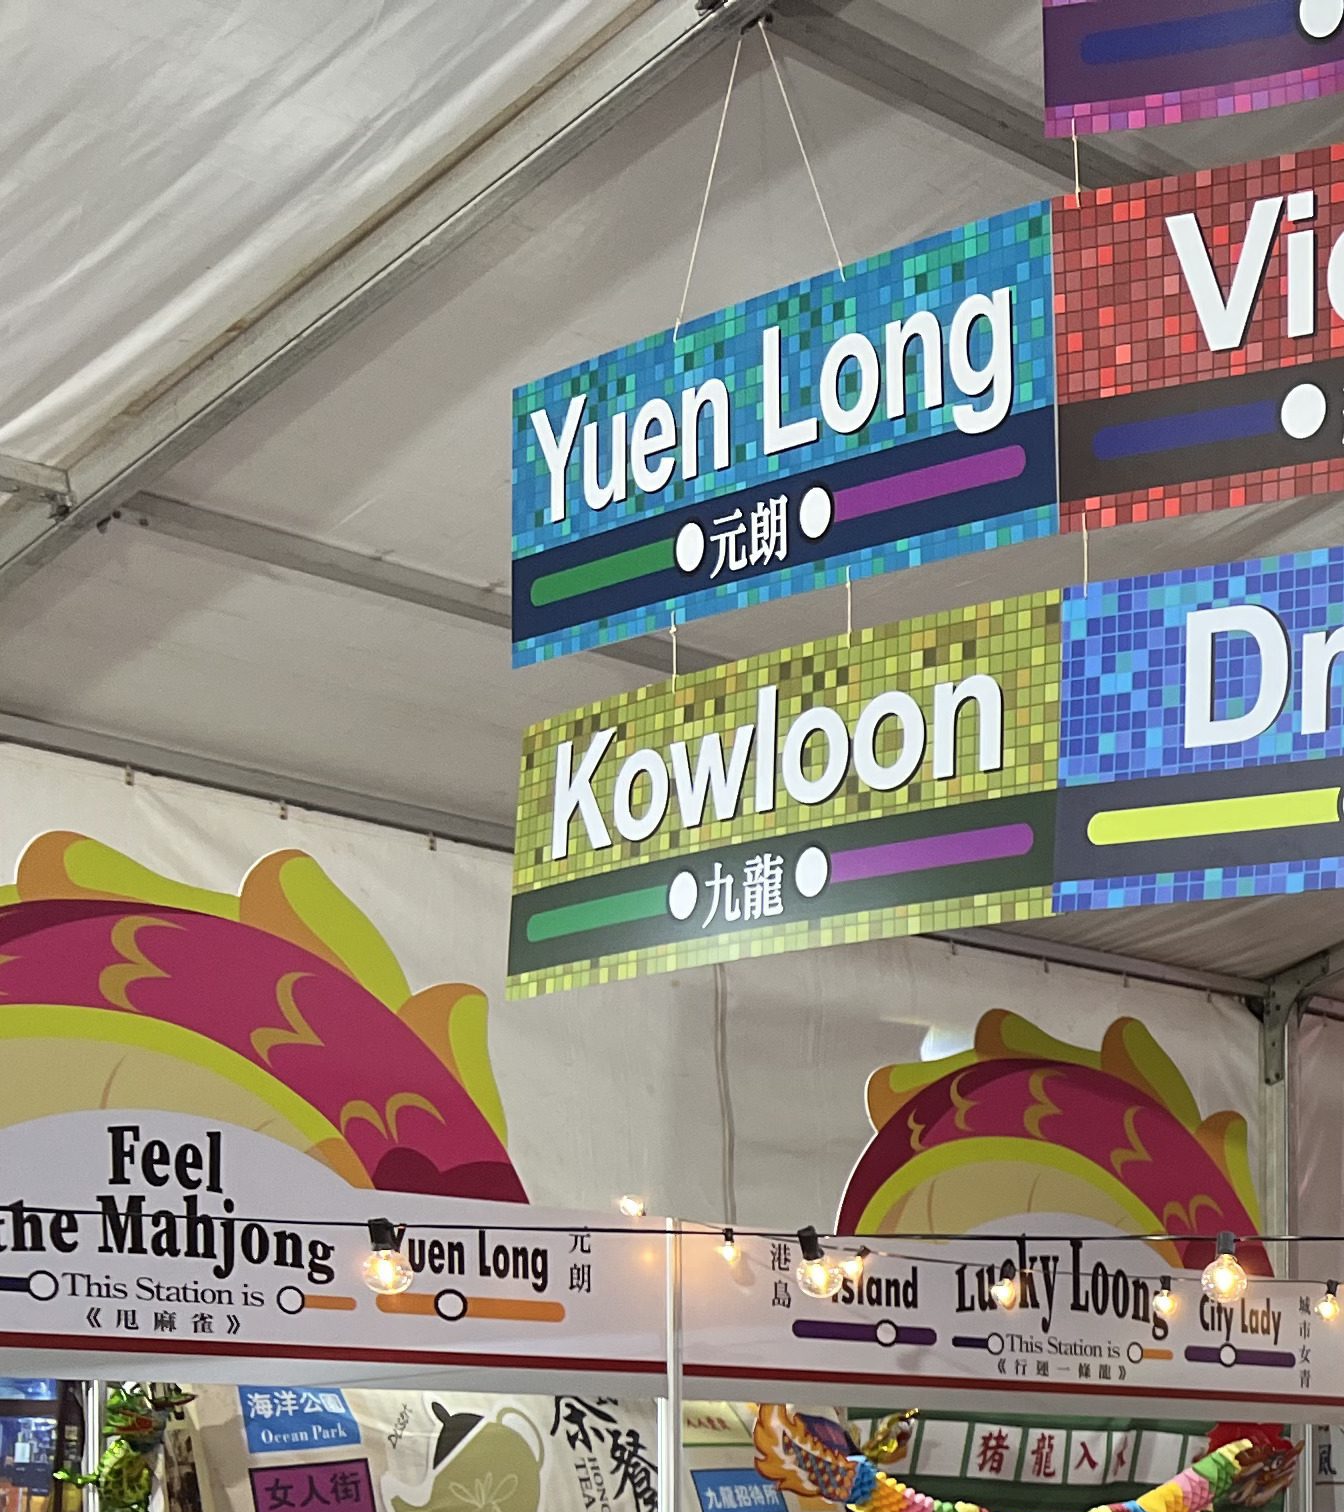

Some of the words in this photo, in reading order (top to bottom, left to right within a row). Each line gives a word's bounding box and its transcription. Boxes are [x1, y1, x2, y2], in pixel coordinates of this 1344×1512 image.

[530, 375, 730, 524] Yuen
[762, 287, 1014, 457] Long
[709, 495, 789, 580] 元朗
[551, 673, 1002, 862] Kowloon
[703, 852, 785, 929] 九龍
[107, 1125, 223, 1193] Feel
[96, 1195, 335, 1285] Mahjong
[478, 1229, 549, 1293] Long
[569, 1226, 592, 1294] 元朗
[61, 1272, 128, 1300] This
[135, 1276, 235, 1307] Station
[242, 1284, 266, 1308] is
[770, 1243, 792, 1309] 港島
[1006, 1333, 1044, 1354] This
[1047, 1337, 1103, 1358] Station
[1107, 1340, 1121, 1358] is
[1199, 1293, 1234, 1342] City
[1241, 1297, 1282, 1346] Lady
[261, 1427, 309, 1445] Ocean
[311, 1422, 348, 1441] Park
[265, 1471, 361, 1511] 女人街
[574, 1457, 597, 1510] TEA
